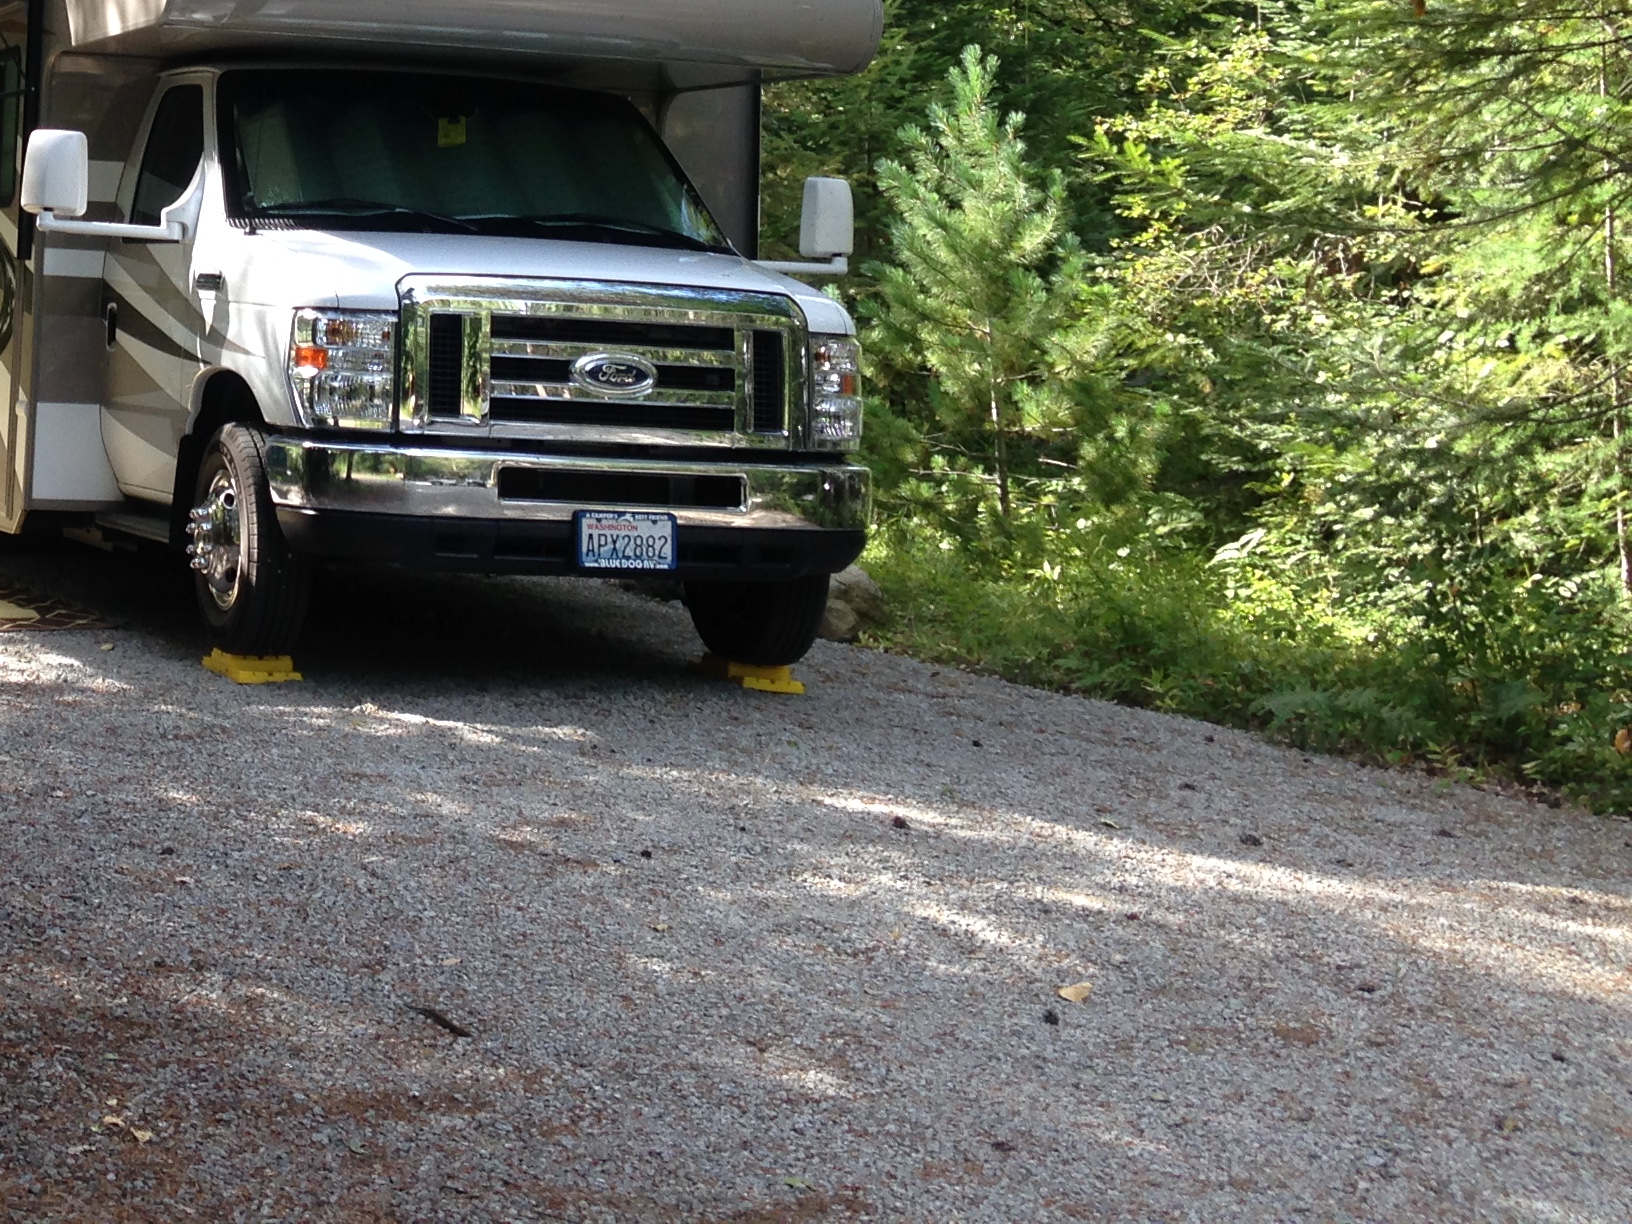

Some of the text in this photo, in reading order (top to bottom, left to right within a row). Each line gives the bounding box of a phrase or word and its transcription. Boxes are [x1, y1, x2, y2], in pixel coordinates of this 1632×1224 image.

[598, 364, 636, 383] Ford
[586, 523, 639, 532] WASHINGTON
[585, 533, 668, 560] APX2882
